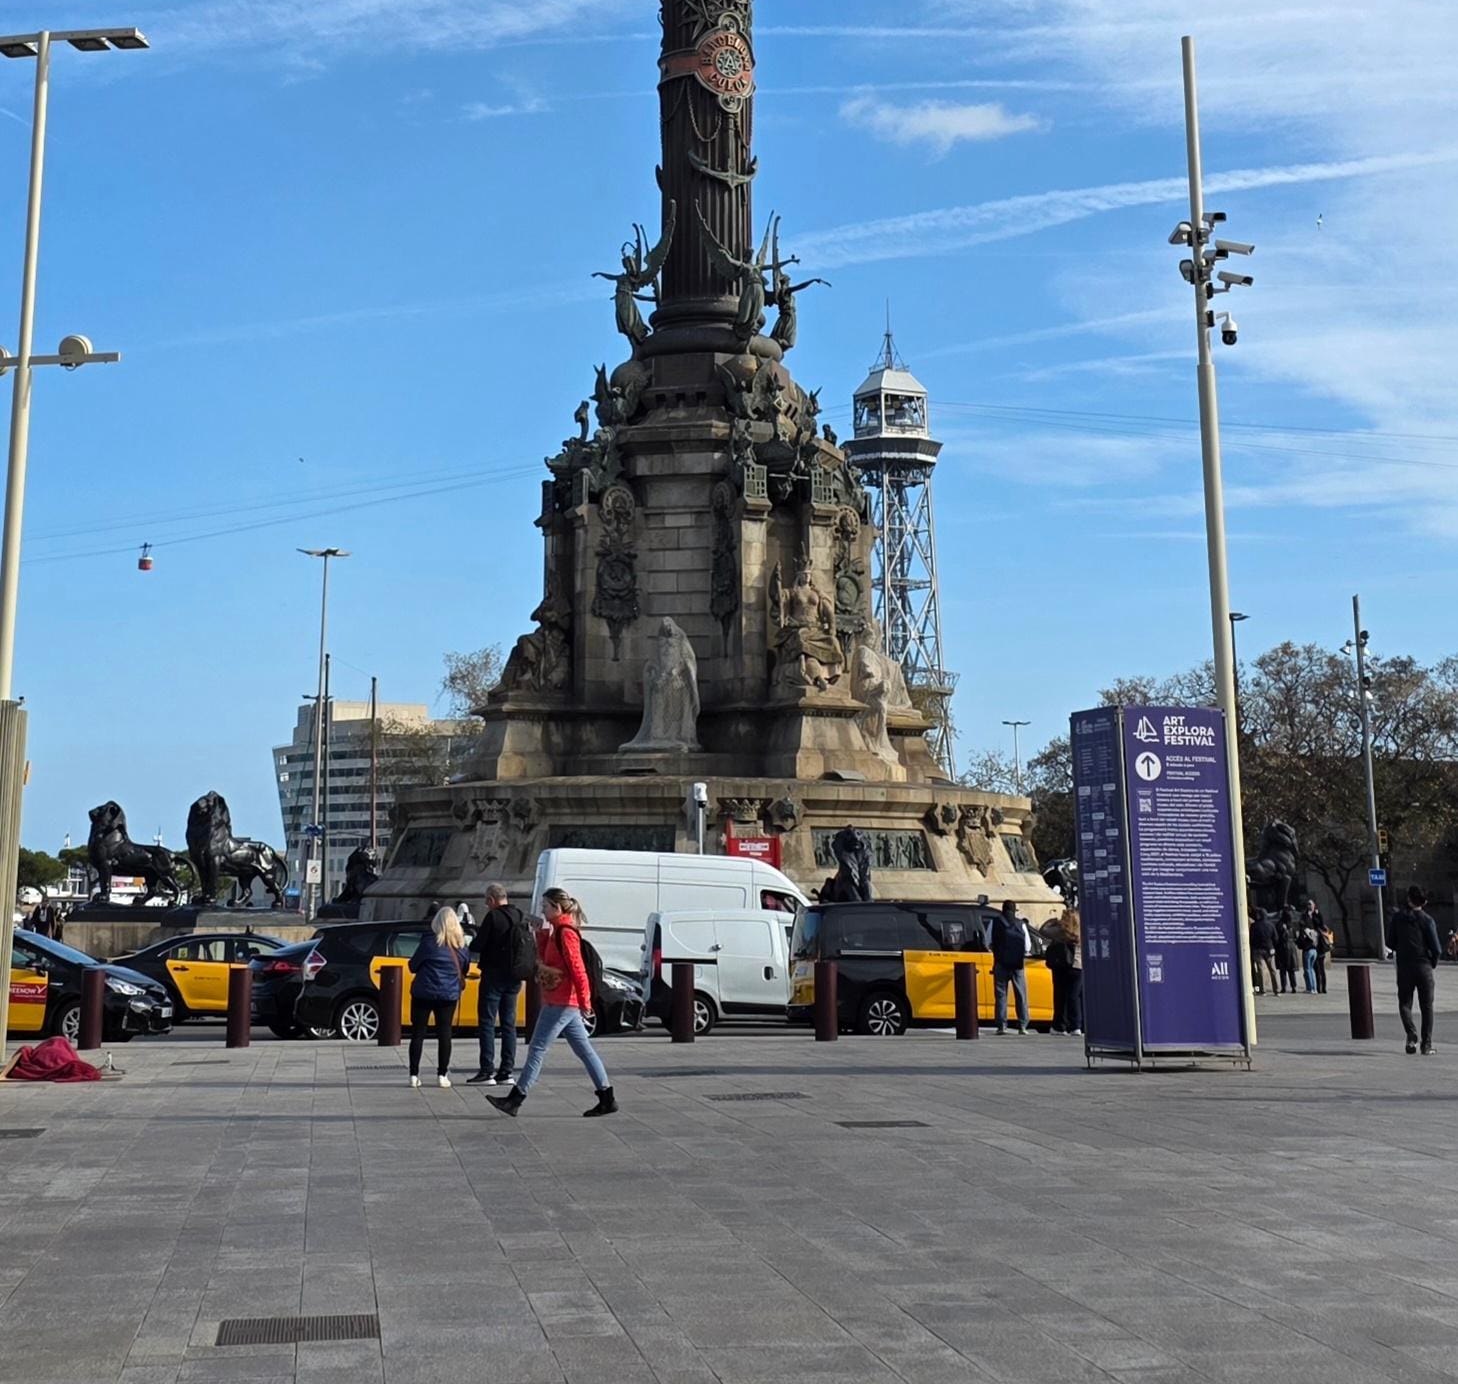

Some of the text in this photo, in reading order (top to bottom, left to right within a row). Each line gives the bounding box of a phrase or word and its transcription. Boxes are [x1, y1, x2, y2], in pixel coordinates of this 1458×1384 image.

[1163, 715, 1186, 726] ART
[1163, 725, 1216, 737] EXPLORA
[1164, 735, 1216, 747] FESTIVAL
